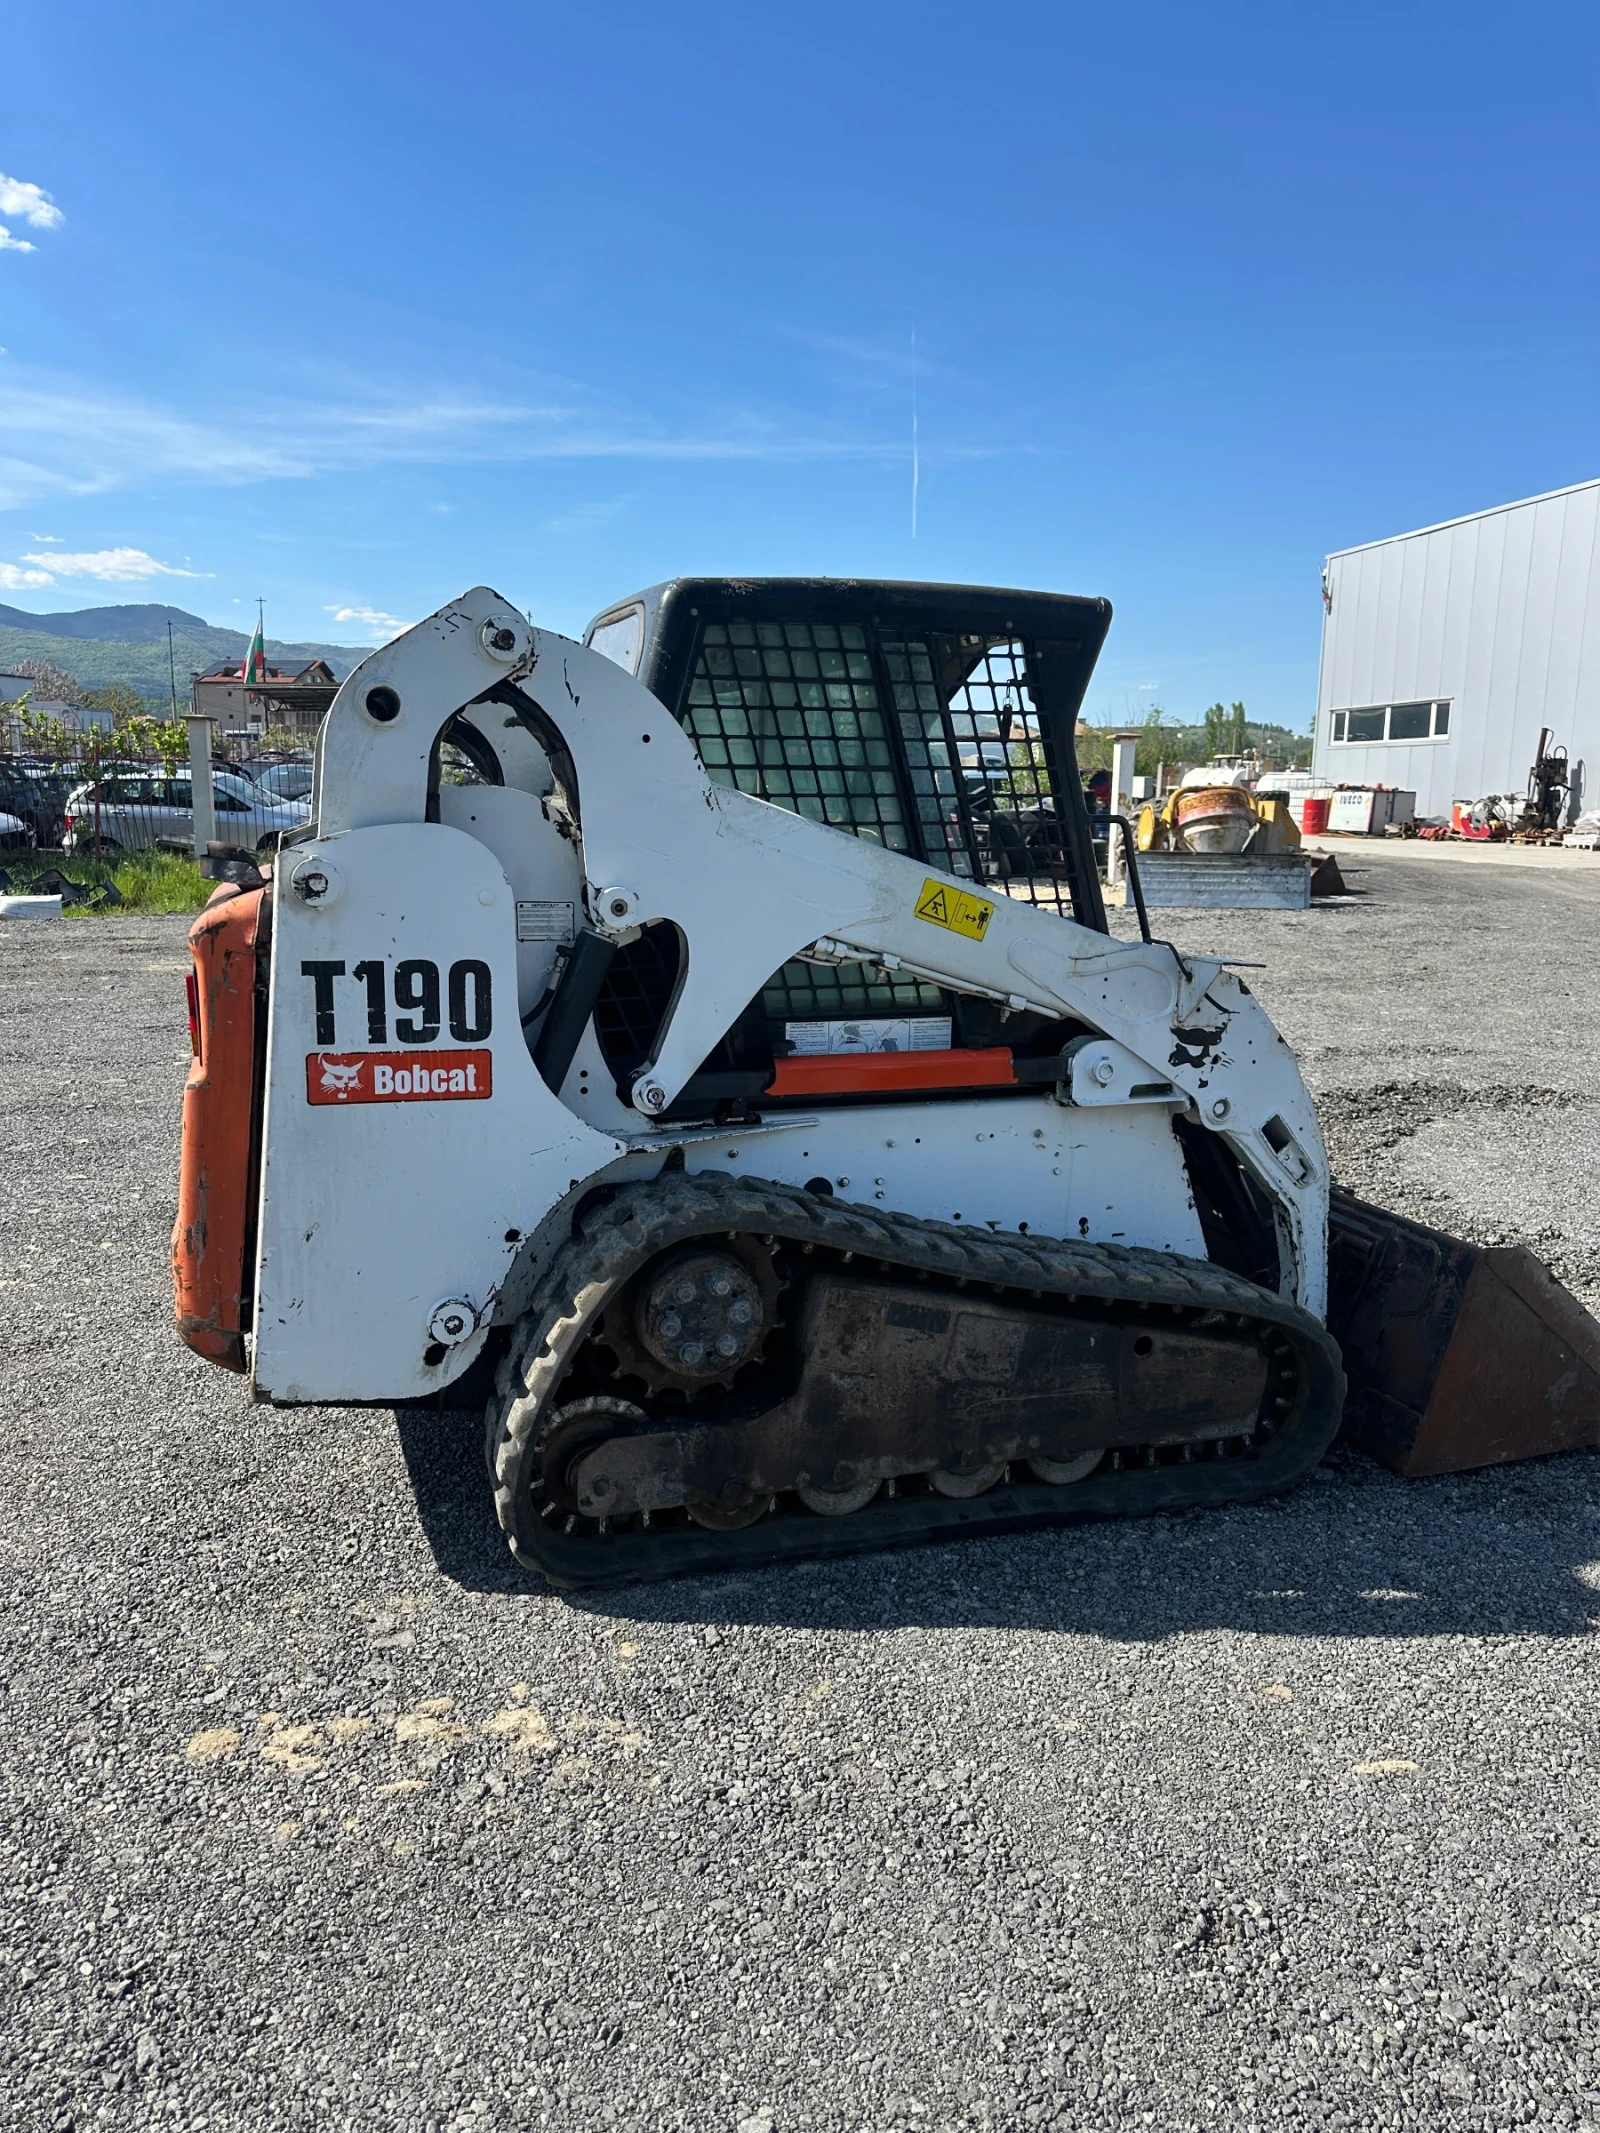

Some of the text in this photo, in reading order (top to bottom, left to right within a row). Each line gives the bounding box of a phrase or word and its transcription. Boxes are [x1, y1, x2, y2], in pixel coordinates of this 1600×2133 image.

[1340, 795, 1363, 805] IVECO
[301, 959, 492, 1045] T190
[374, 1064, 477, 1095] Bobcat
